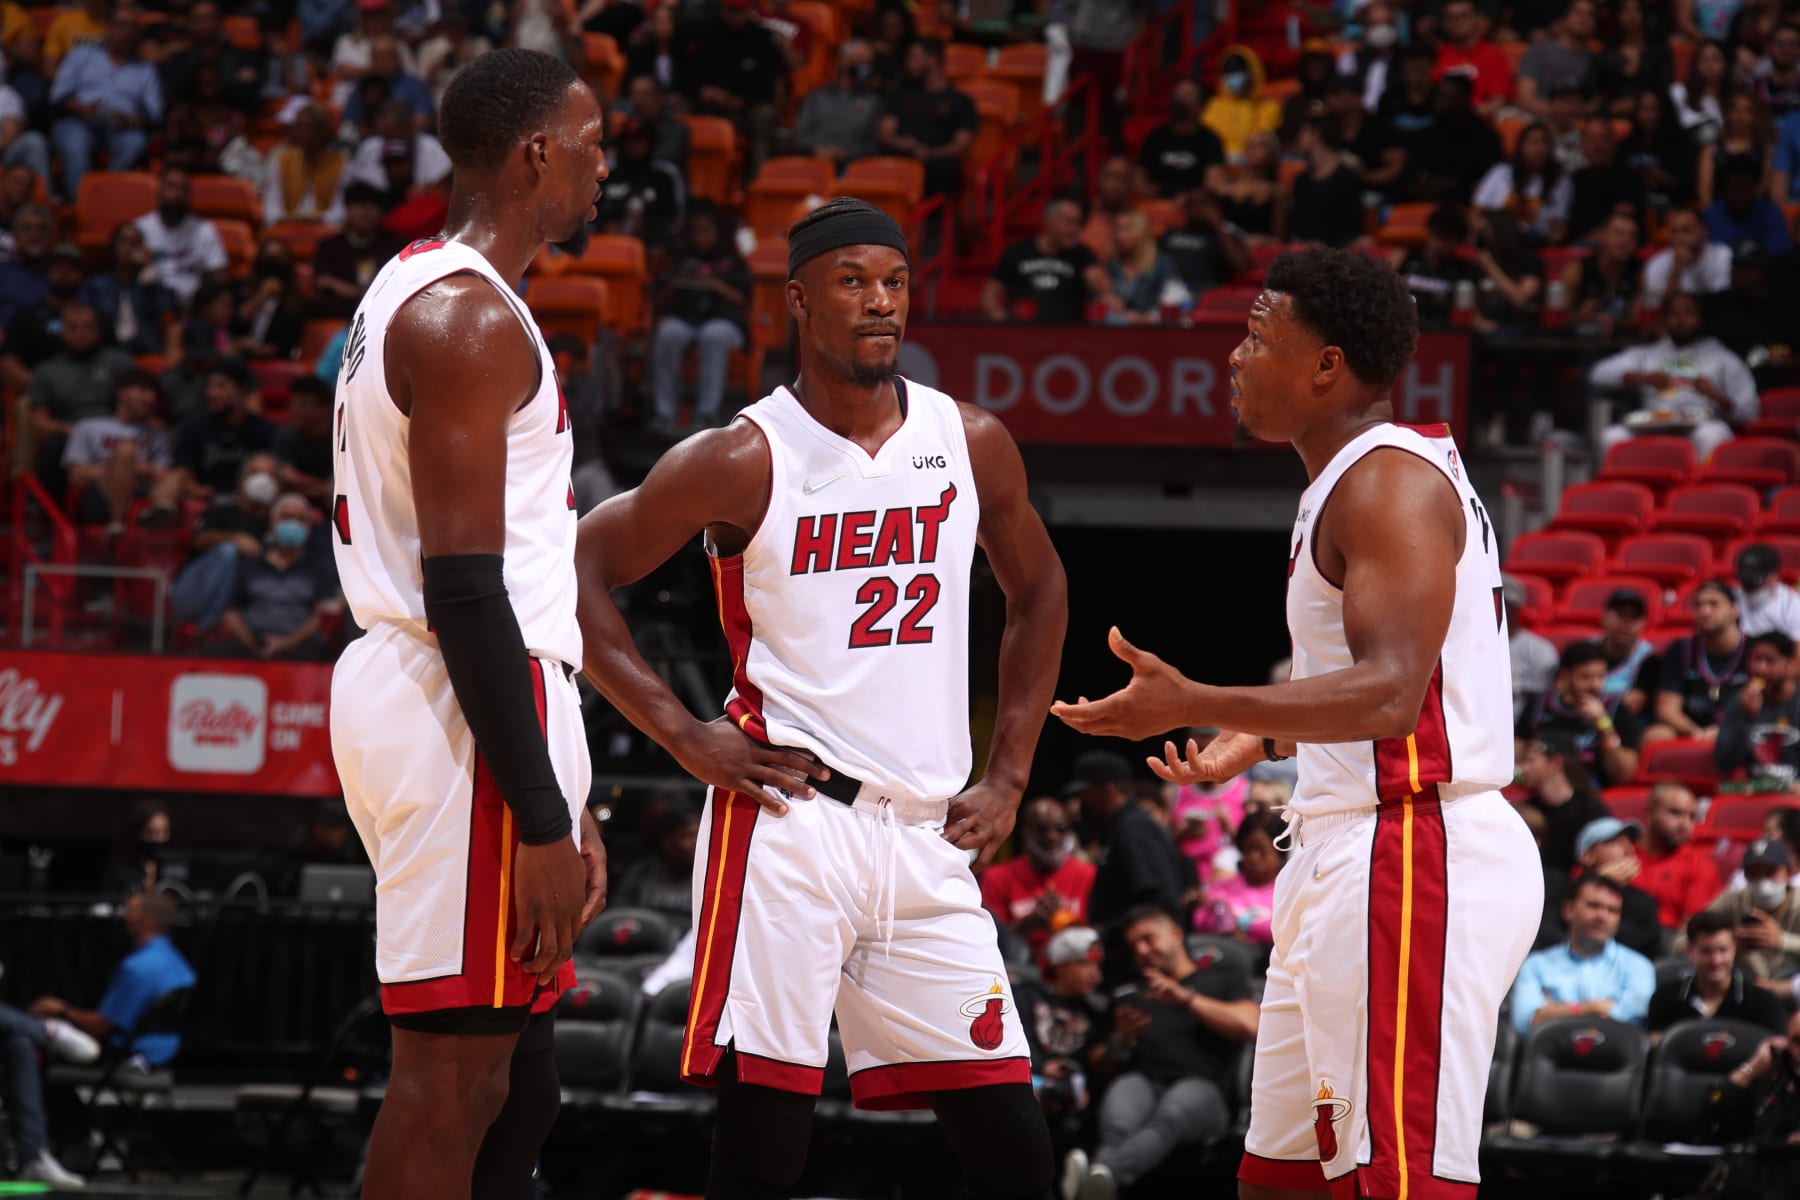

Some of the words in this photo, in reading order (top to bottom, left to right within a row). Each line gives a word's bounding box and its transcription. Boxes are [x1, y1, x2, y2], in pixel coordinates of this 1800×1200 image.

[790, 481, 957, 576] HEAT
[848, 573, 941, 649] 22
[0, 668, 64, 752] lly
[270, 729, 301, 751] ON
